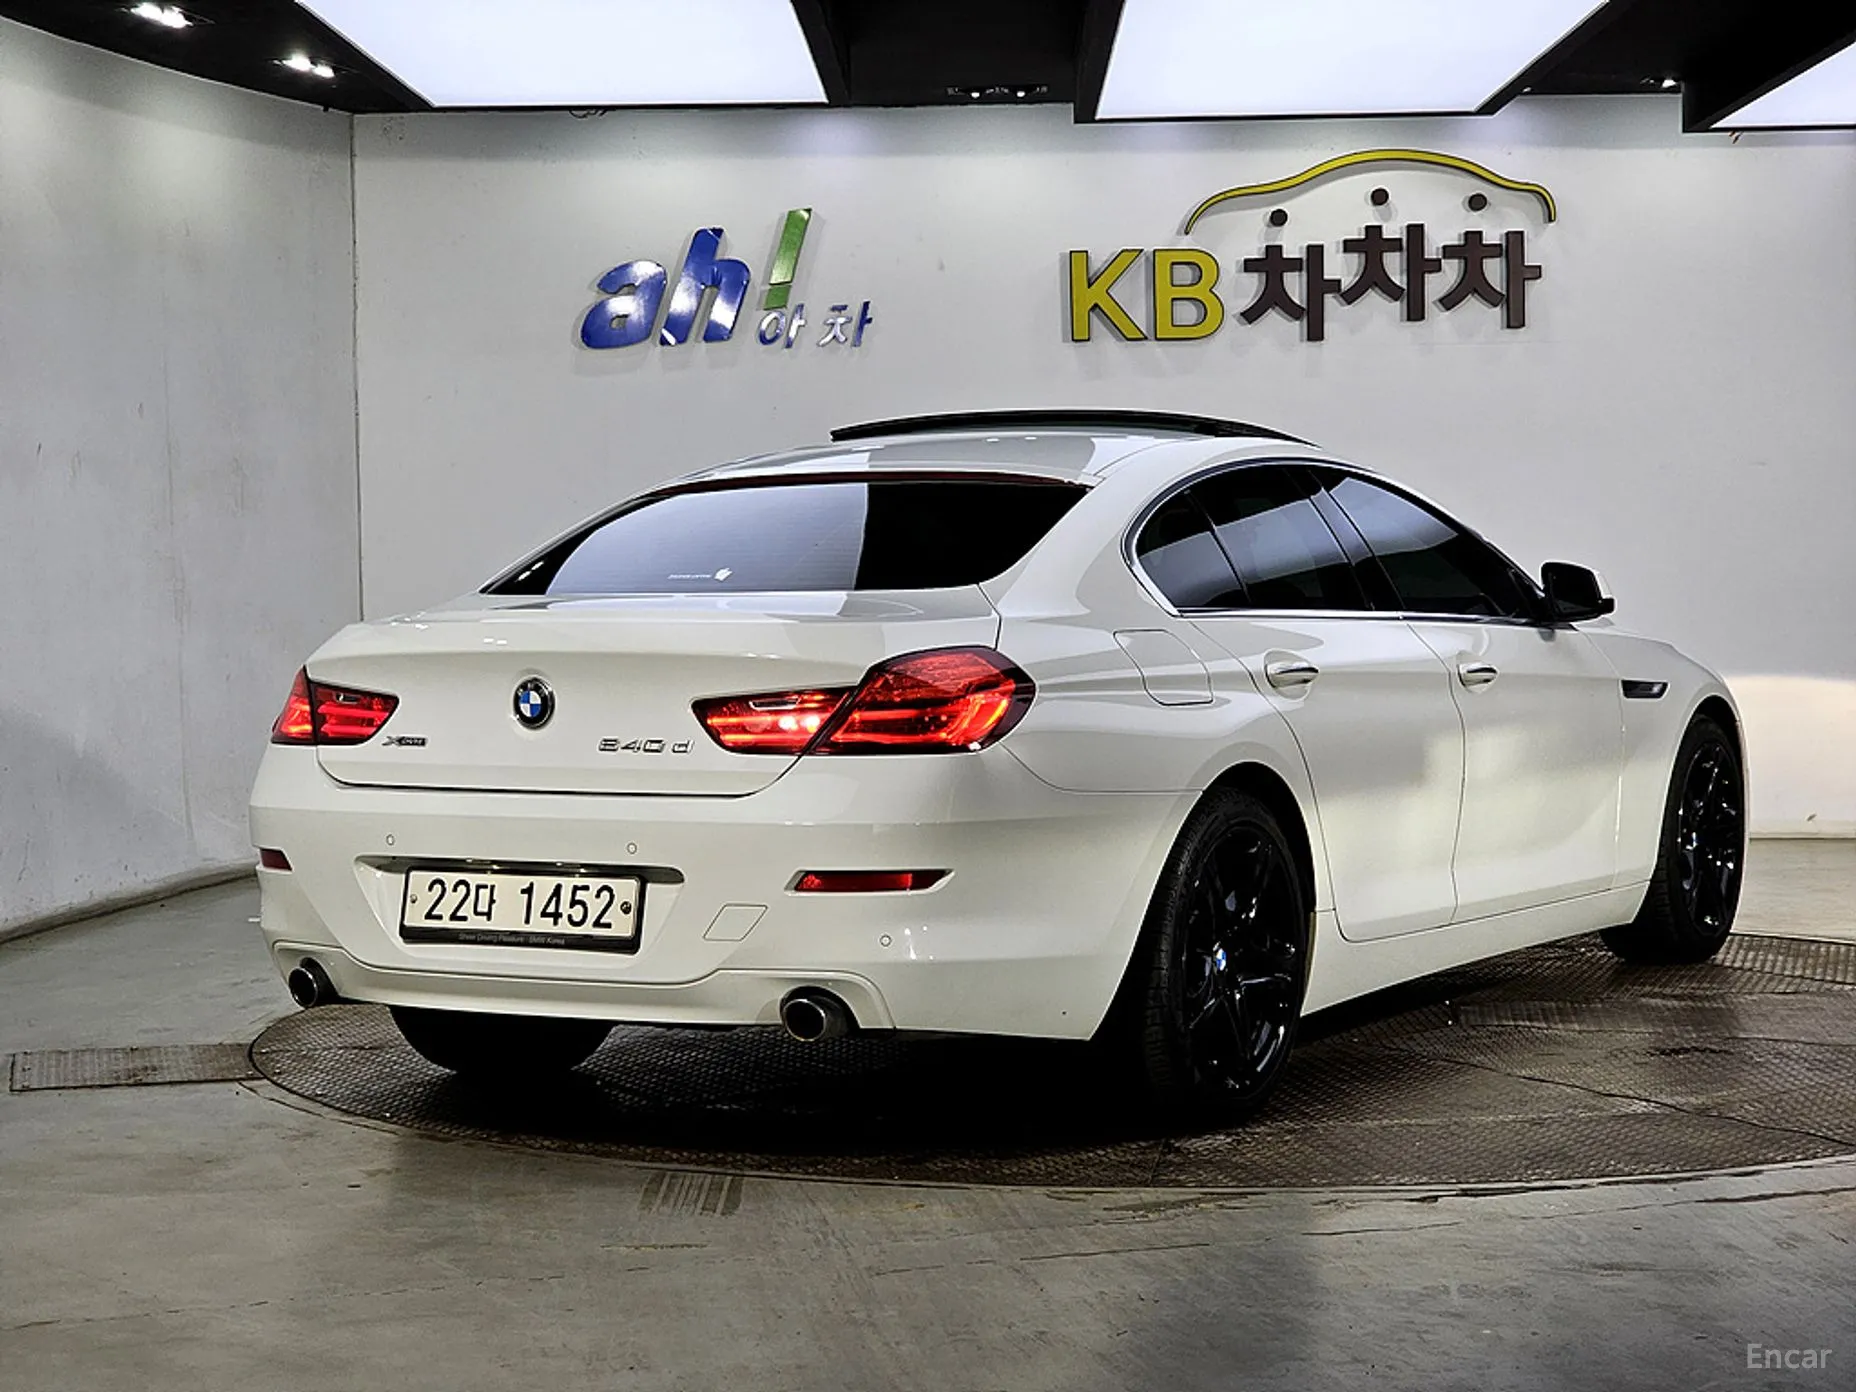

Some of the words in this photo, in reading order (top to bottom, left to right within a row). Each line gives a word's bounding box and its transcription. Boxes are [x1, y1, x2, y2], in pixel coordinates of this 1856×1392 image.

[1069, 248, 1225, 342] KB
[1239, 221, 1542, 342] 차차차
[424, 878, 497, 922] 22다
[520, 881, 616, 929] 1452
